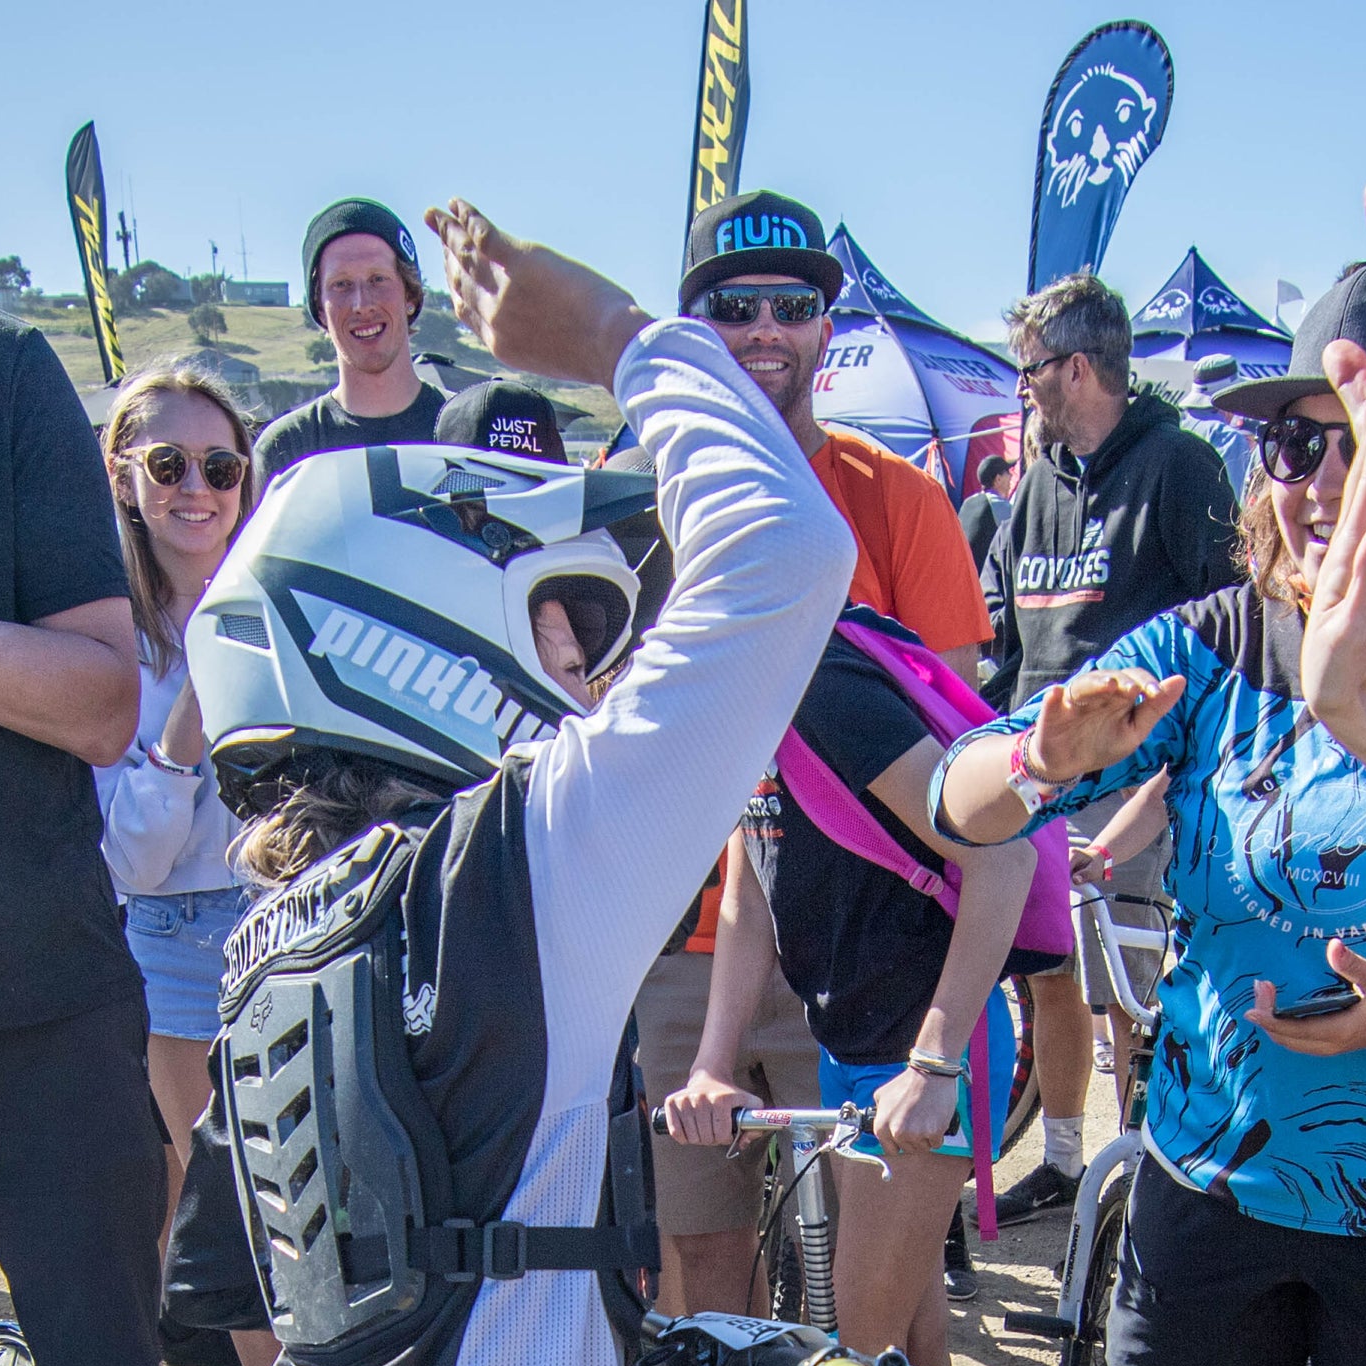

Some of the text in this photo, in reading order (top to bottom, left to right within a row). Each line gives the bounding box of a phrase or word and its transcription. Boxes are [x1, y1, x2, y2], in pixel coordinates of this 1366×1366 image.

[491, 417, 537, 435] JUST
[488, 433, 543, 453] PEDAL
[1016, 549, 1111, 590] COYOTES
[1284, 866, 1361, 888] MCXCVIII
[1224, 860, 1294, 934] DESIGNED
[1303, 925, 1325, 940] IN
